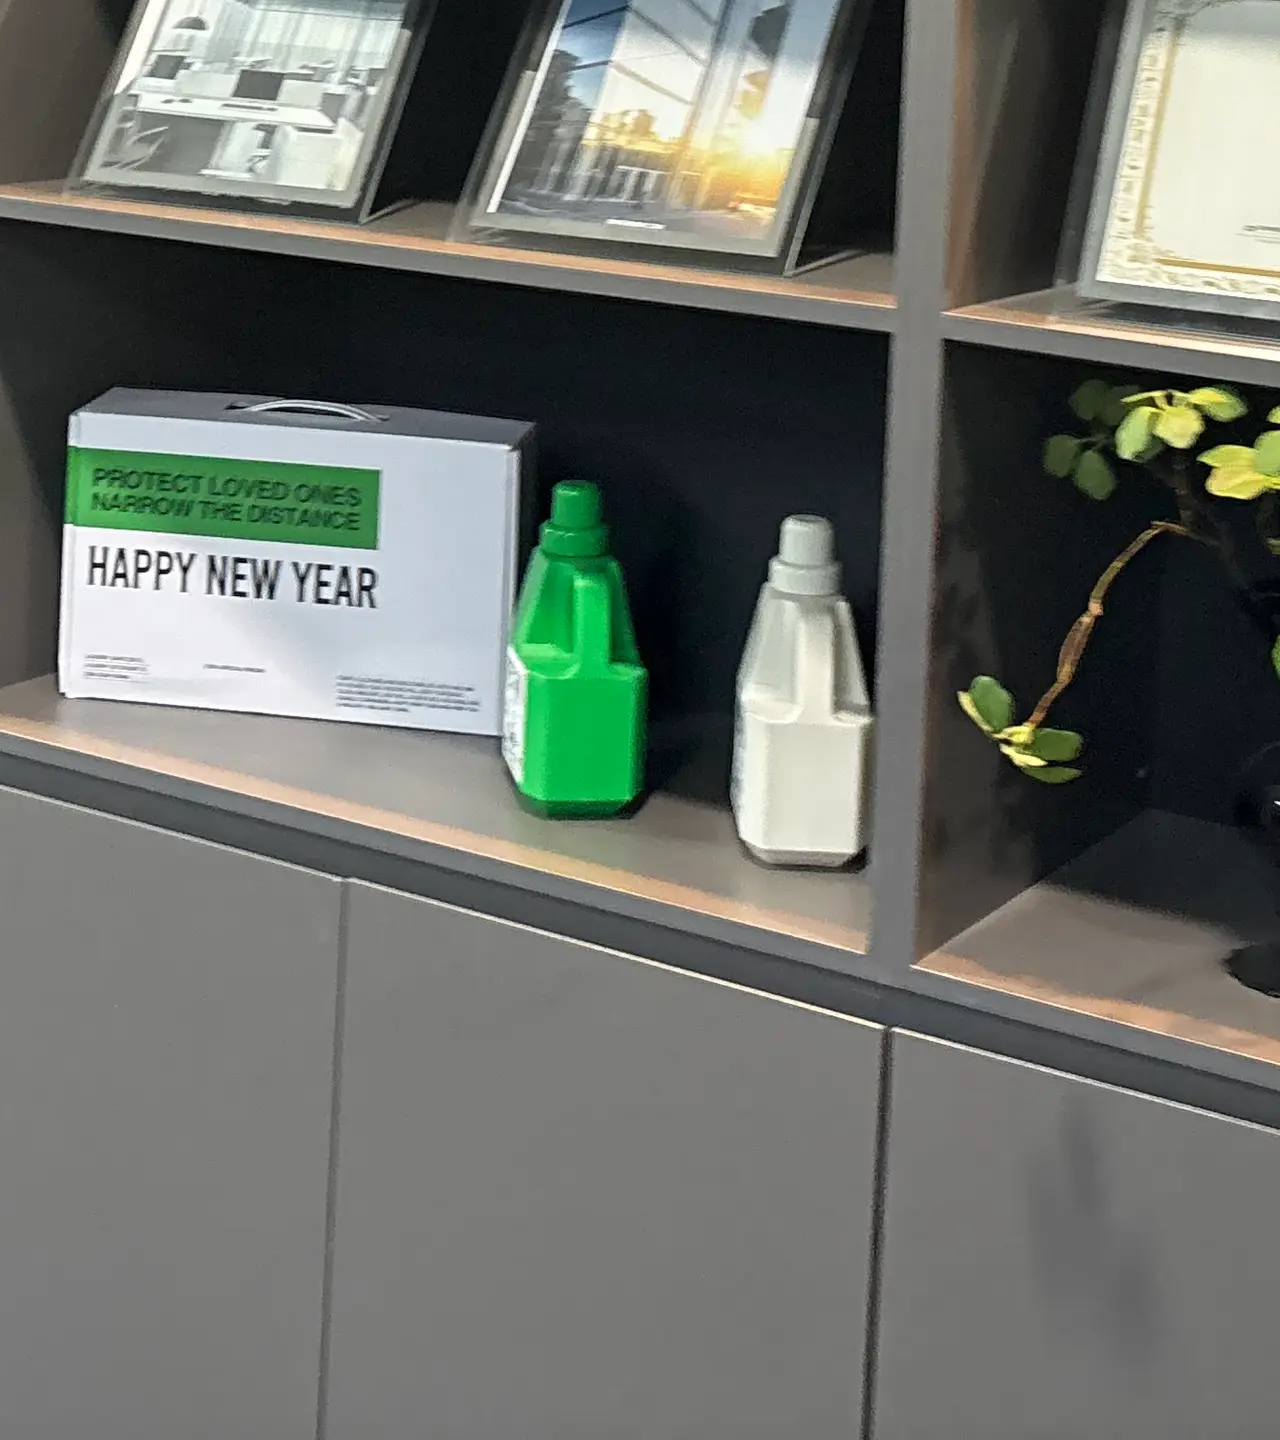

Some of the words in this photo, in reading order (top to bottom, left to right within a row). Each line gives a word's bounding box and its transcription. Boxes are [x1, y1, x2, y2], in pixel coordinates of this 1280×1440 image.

[92, 467, 204, 494] PROTECT
[208, 475, 292, 500] LOVED
[294, 483, 362, 508] ONES
[91, 492, 197, 517] NARROW
[199, 500, 243, 522] THE
[247, 504, 361, 531] DISTANCE
[86, 545, 198, 593] HAPPY
[204, 554, 284, 600] NEW
[291, 561, 380, 609] YEAR
